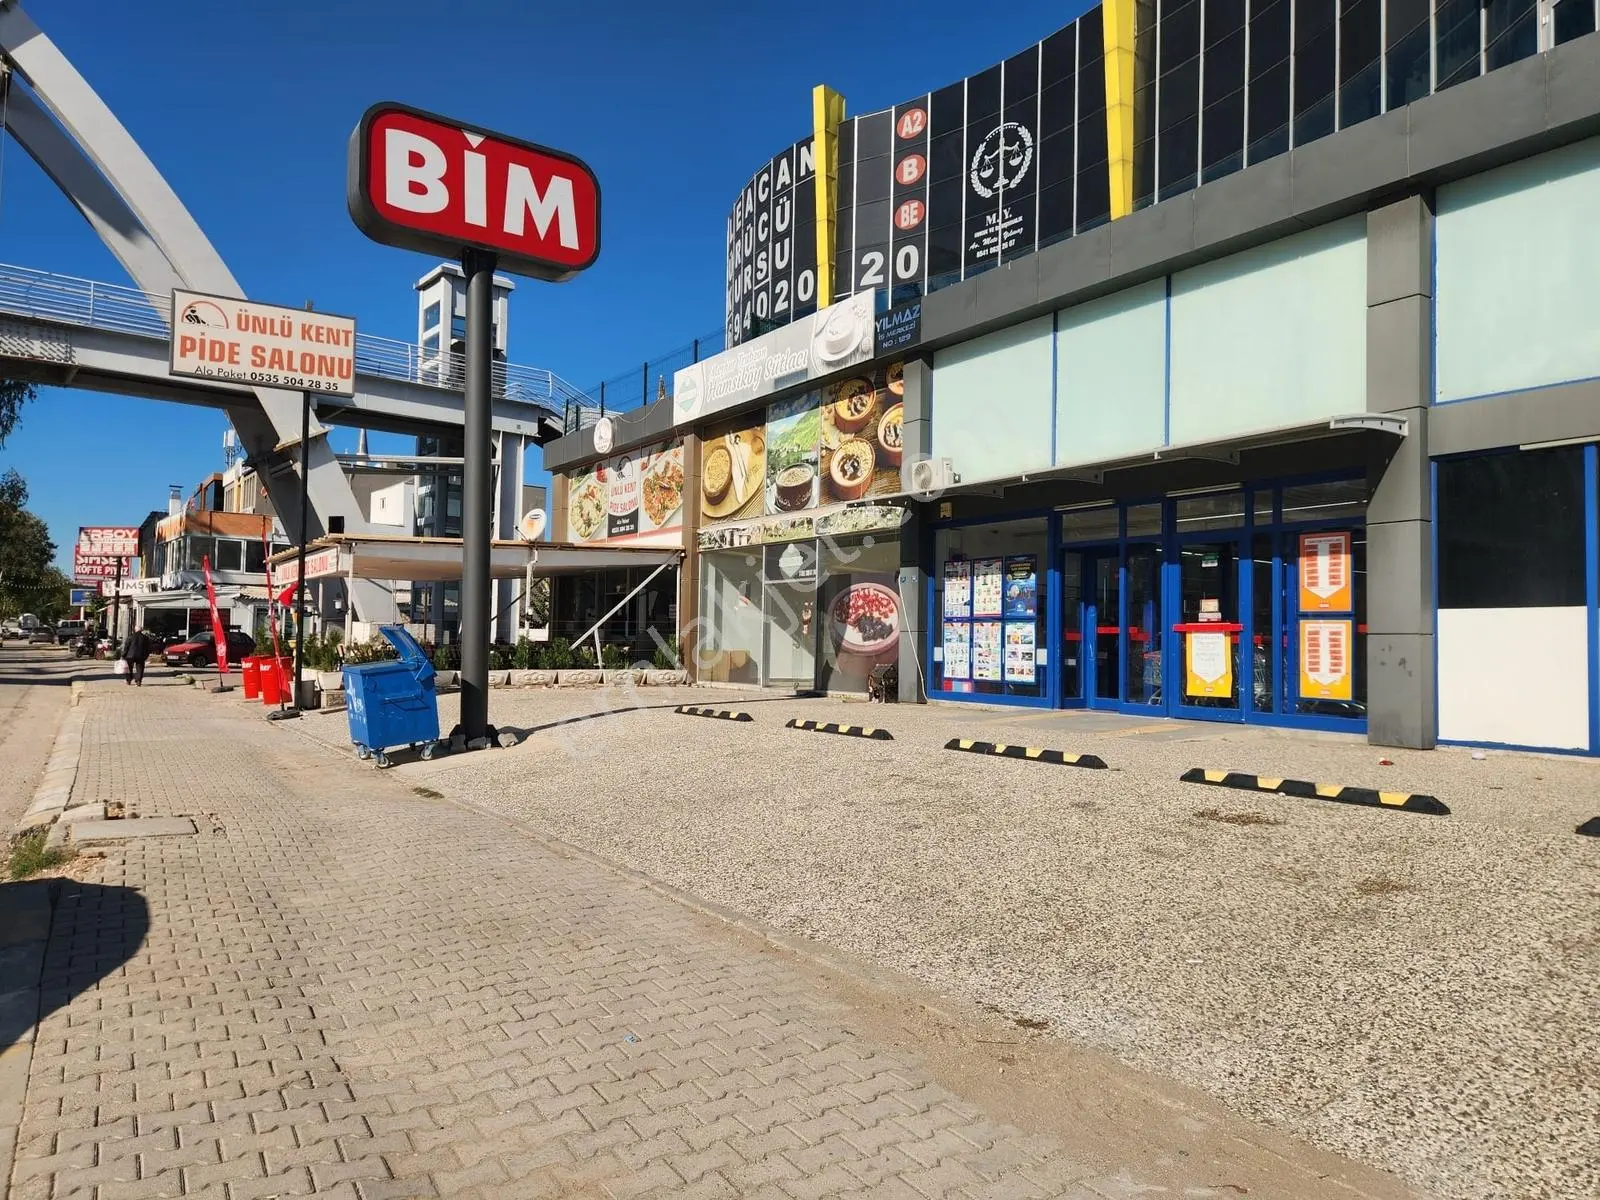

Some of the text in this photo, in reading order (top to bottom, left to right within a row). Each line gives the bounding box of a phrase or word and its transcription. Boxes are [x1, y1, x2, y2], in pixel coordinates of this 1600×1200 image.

[901, 111, 921, 139] A2
[902, 158, 918, 182] B
[385, 128, 580, 250] BİM
[899, 203, 919, 228] BE
[236, 308, 352, 347] ÜNLÜ KENT
[875, 304, 921, 333] YILMAZ
[179, 331, 352, 380] PİDE SALONU
[194, 366, 338, 391] Alo Paket 0535 504 28 35
[75, 564, 103, 576] KÖFTE
